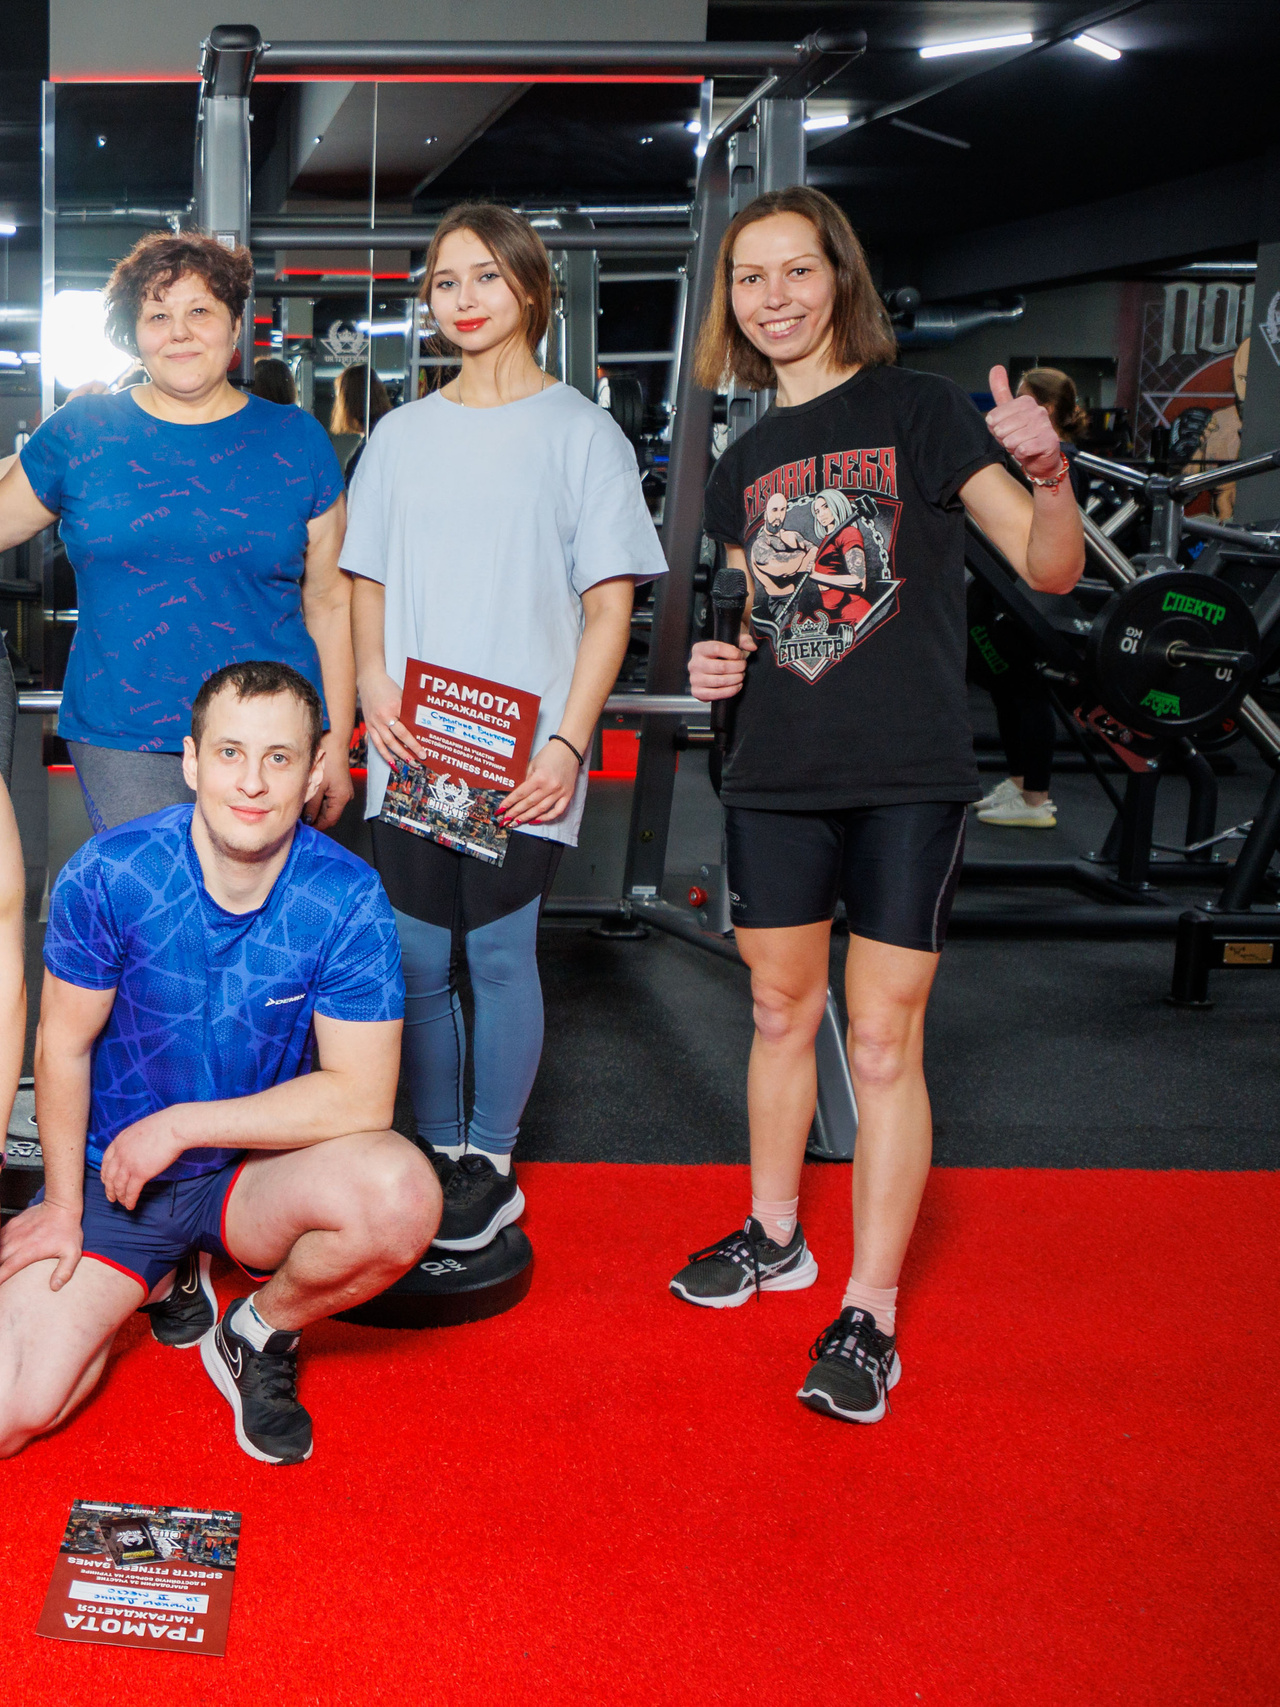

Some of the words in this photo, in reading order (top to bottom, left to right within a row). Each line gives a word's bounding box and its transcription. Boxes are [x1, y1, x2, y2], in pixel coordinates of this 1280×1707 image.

[822, 446, 899, 500] СЕБЯ
[1162, 591, 1227, 626] СПЕКТР
[1125, 626, 1143, 639] KG
[778, 638, 845, 666] СПЕКТР
[1120, 637, 1138, 655] 10
[420, 673, 521, 720] ГРАМОТА
[427, 695, 511, 729] НАГРАЖДАЕТСЯ
[472, 749, 495, 761] УЧАСТИЕ
[441, 754, 481, 775] FITNESS
[483, 770, 515, 788] GAMES
[420, 1262, 451, 1276] 10
[442, 1259, 468, 1271] KG
[67, 1556, 111, 1569] GAMES
[96, 1576, 129, 1584] УЧАСТИЕ
[172, 1569, 223, 1580] SPEKTR
[77, 1604, 194, 1624] НАГРАЖДАЕТСЯ
[63, 1612, 205, 1643] ГРАМОТА
